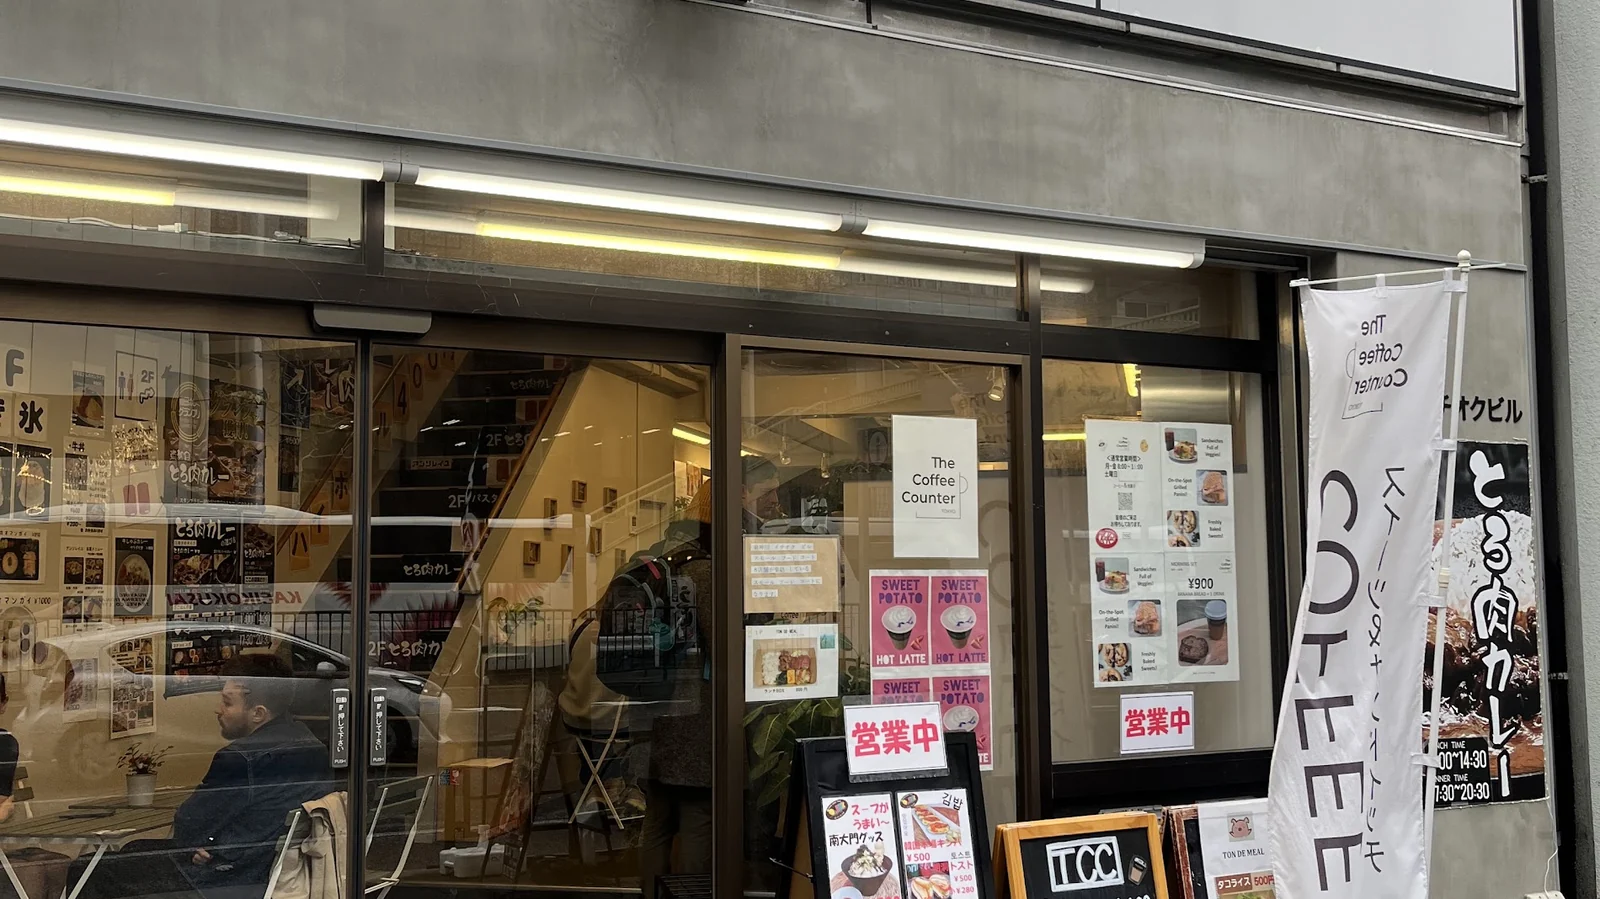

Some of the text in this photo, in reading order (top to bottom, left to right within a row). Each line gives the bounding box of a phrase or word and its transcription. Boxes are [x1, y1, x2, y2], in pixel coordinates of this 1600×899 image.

[141, 370, 154, 383] 2F
[486, 434, 502, 446] 2F
[931, 457, 955, 469] The
[170, 463, 229, 485] とろ肉カレー
[912, 473, 956, 486] Coffee
[448, 495, 465, 508] 2F
[901, 491, 956, 504] Counter
[175, 517, 235, 540] とろ肉カレー
[404, 563, 462, 576] とろ肉カレー
[882, 579, 920, 591] SWEET
[941, 580, 978, 591] SWEET
[1188, 578, 1213, 589] ¥900
[879, 592, 923, 604] POTATO
[938, 592, 981, 604] POTATO
[1470, 450, 1516, 797] とろ肉カレー
[368, 641, 385, 656] 2F
[876, 654, 926, 665] HOT LATTE
[936, 652, 986, 664] HOT LATTE
[884, 682, 920, 694] SWEET
[943, 679, 980, 692] SWEET
[941, 693, 984, 704] POTATO
[1125, 706, 1191, 738] 営業中
[852, 718, 939, 757] 営業中
[942, 793, 963, 812] 김밥
[907, 853, 930, 862] ¥500
[951, 851, 971, 859] 토스트
[1222, 851, 1236, 859] TON
[1246, 848, 1265, 856] MEAL
[951, 860, 973, 870] トスト
[1051, 844, 1117, 884] TCC
[1218, 877, 1250, 889] タコライス
